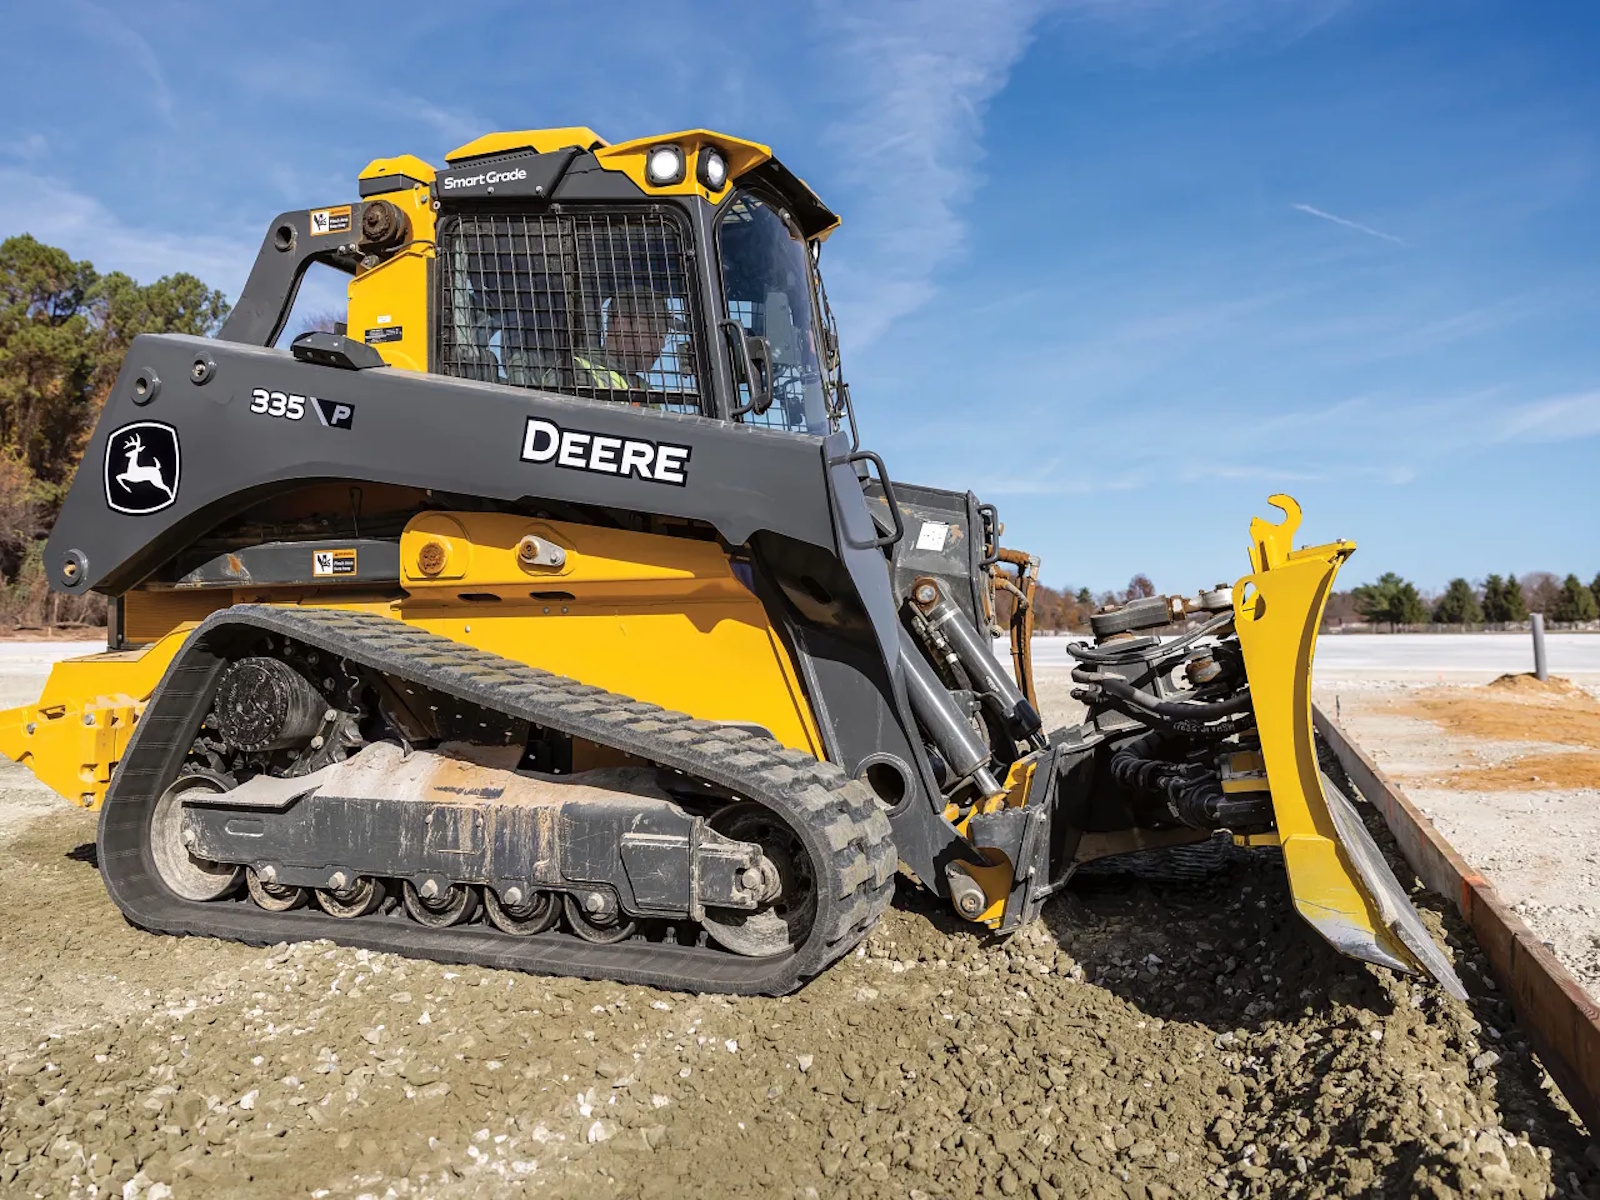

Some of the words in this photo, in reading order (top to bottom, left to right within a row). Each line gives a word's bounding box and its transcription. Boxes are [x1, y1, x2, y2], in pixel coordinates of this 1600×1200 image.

[444, 174, 485, 190] Smart
[486, 168, 527, 184] Grade
[250, 388, 306, 421] 335
[520, 417, 690, 485] DEERE
